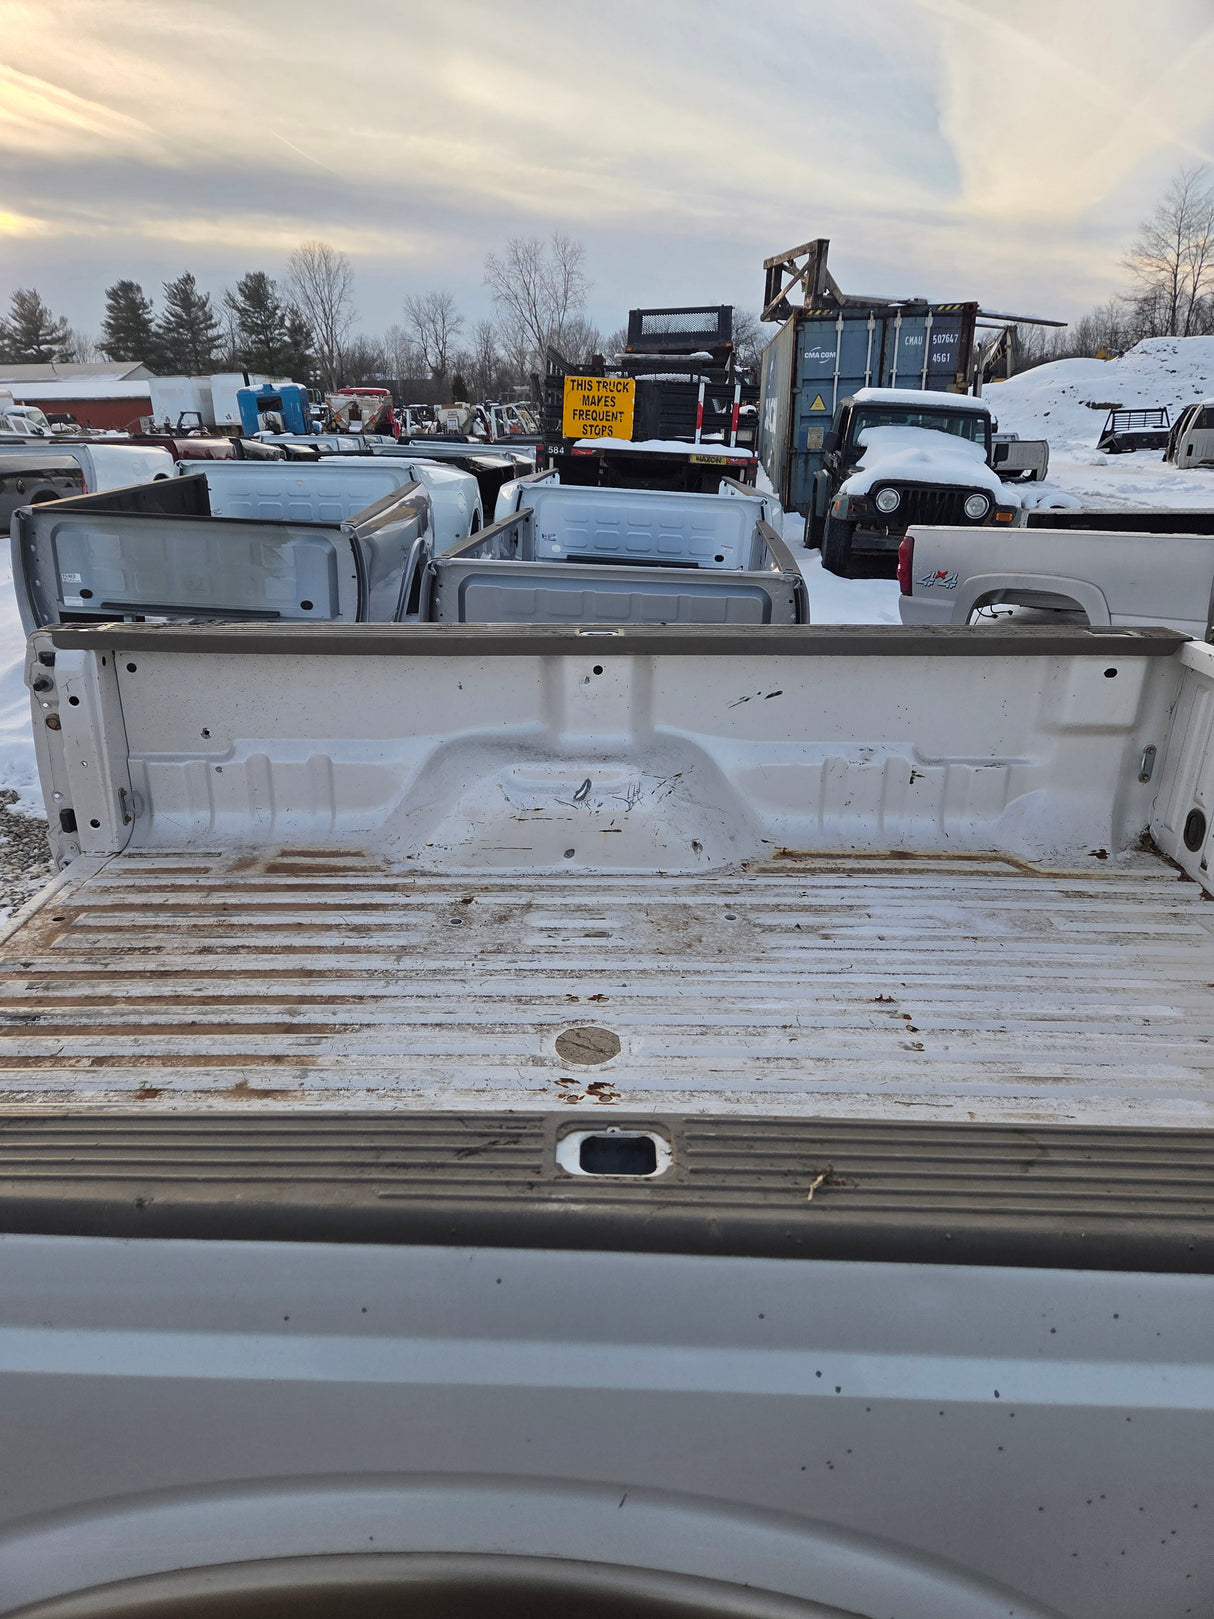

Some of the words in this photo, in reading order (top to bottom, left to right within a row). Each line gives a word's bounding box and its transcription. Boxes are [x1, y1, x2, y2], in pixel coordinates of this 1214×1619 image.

[904, 335, 923, 346] CMAU
[932, 333, 959, 344] 507647
[804, 351, 820, 359] CMA
[932, 352, 951, 363] 45G1
[570, 379, 593, 391] THIS
[596, 380, 630, 393] TRUCK
[582, 394, 616, 407] MAKES
[572, 408, 625, 423] FREQUENT
[582, 423, 614, 437] STOPS
[548, 445, 565, 454] 584
